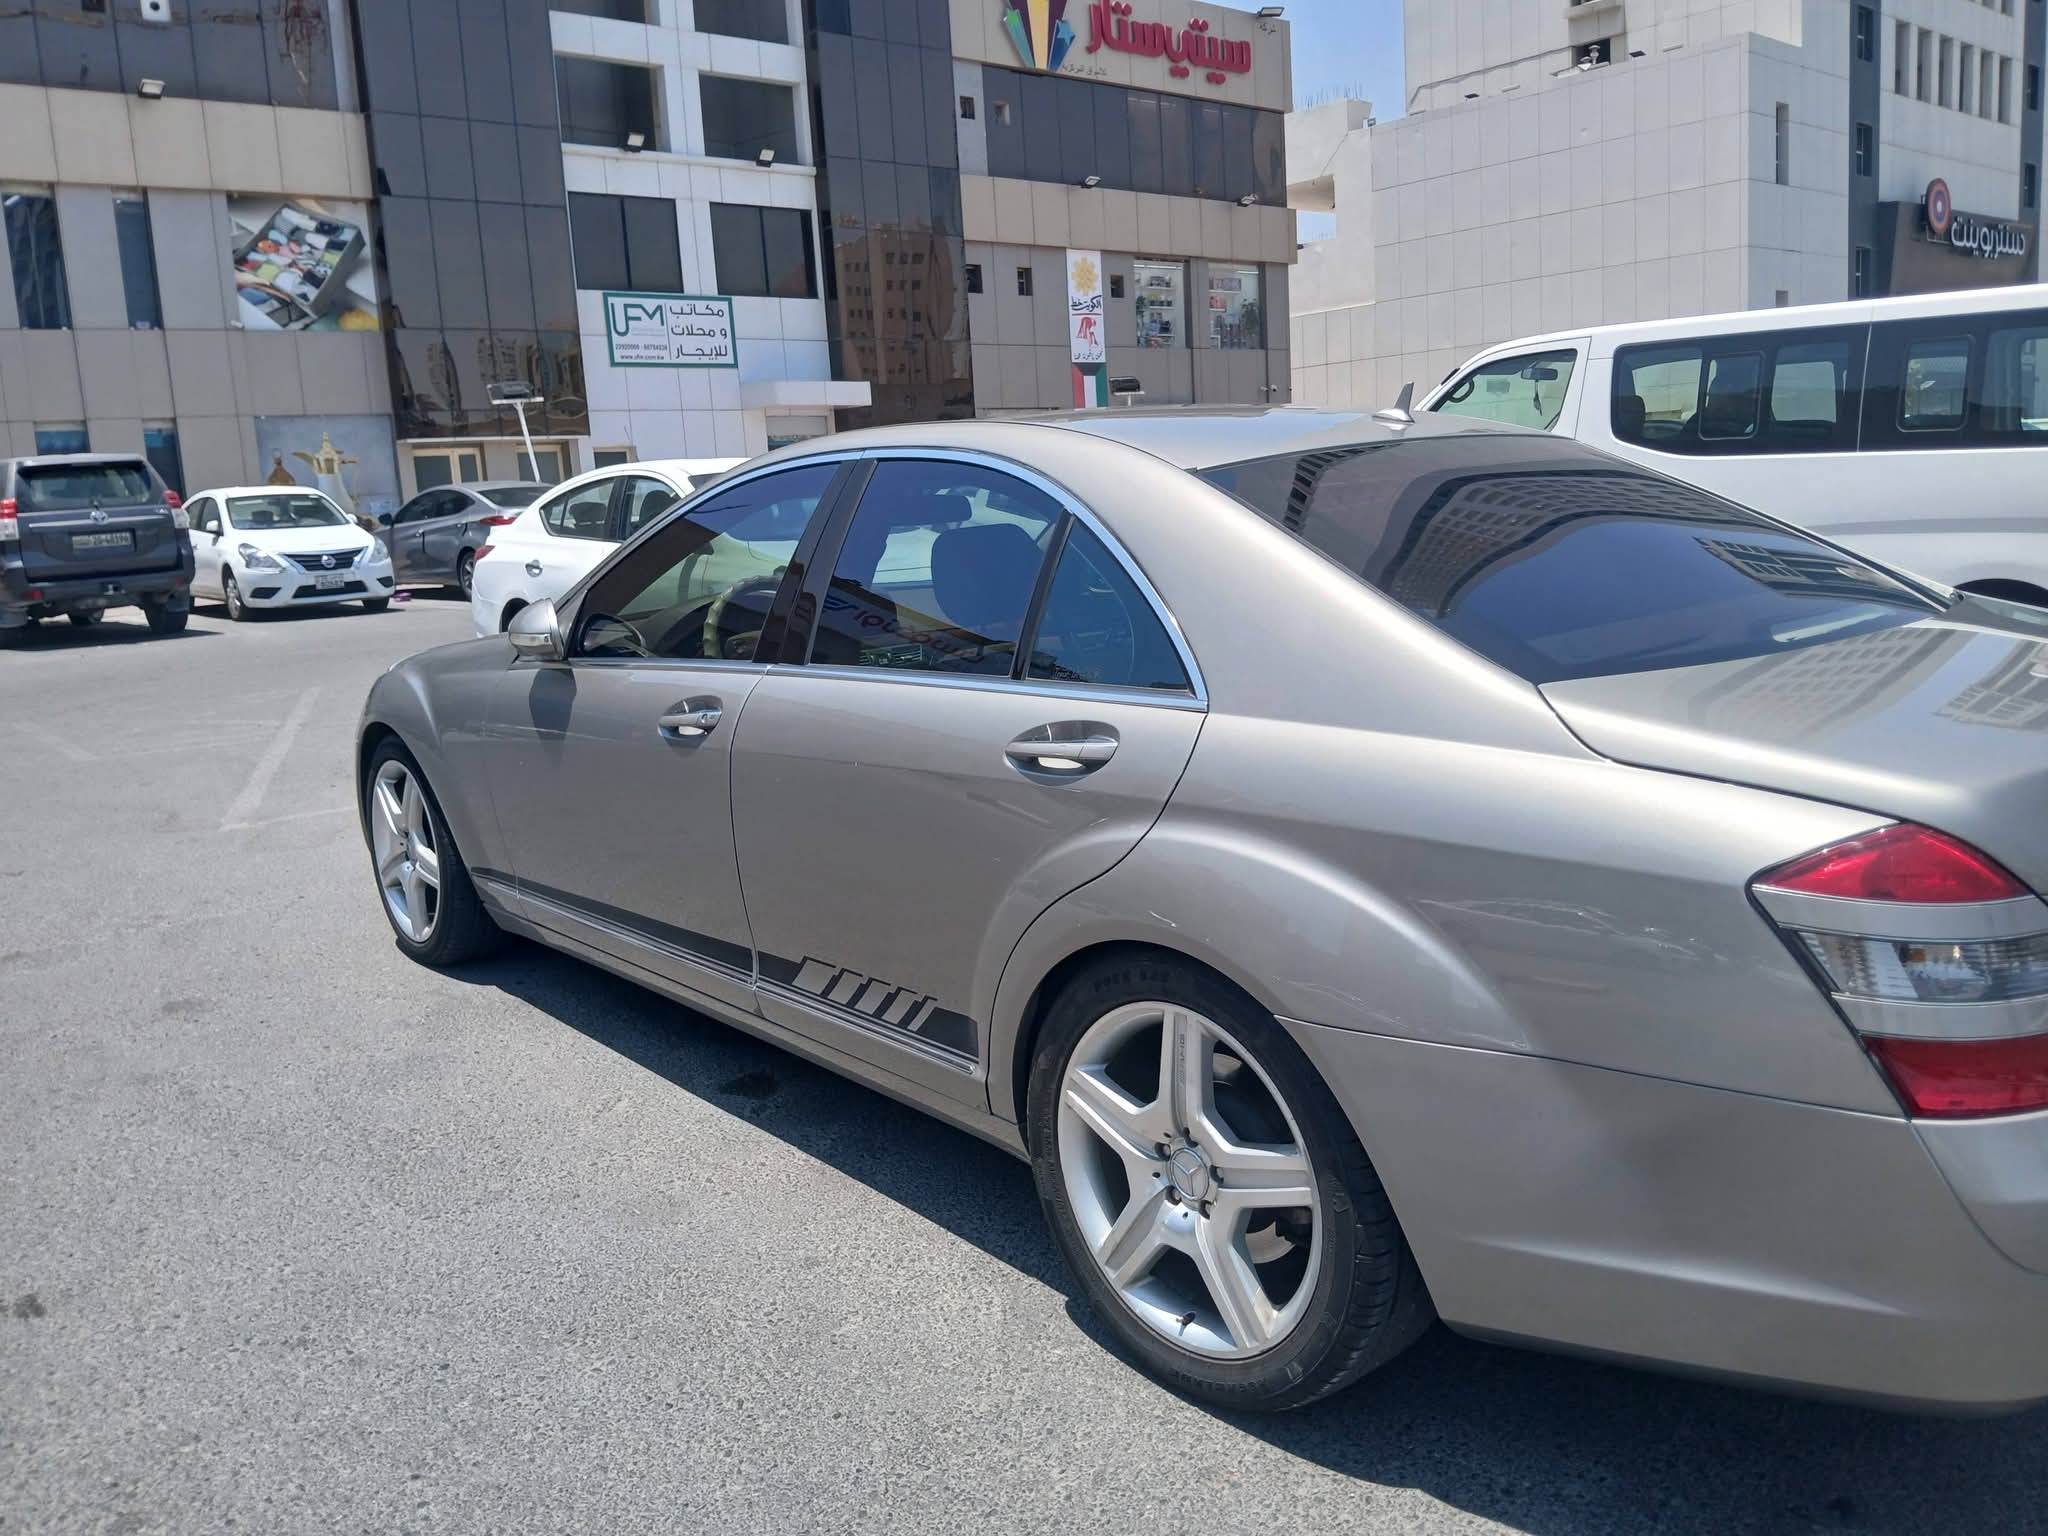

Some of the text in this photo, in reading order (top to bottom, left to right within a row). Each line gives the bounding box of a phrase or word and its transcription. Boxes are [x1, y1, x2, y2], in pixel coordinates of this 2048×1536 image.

[669, 303, 725, 319] مكاتب
[610, 303, 665, 337] UFM
[675, 344, 728, 360] للإيجار
